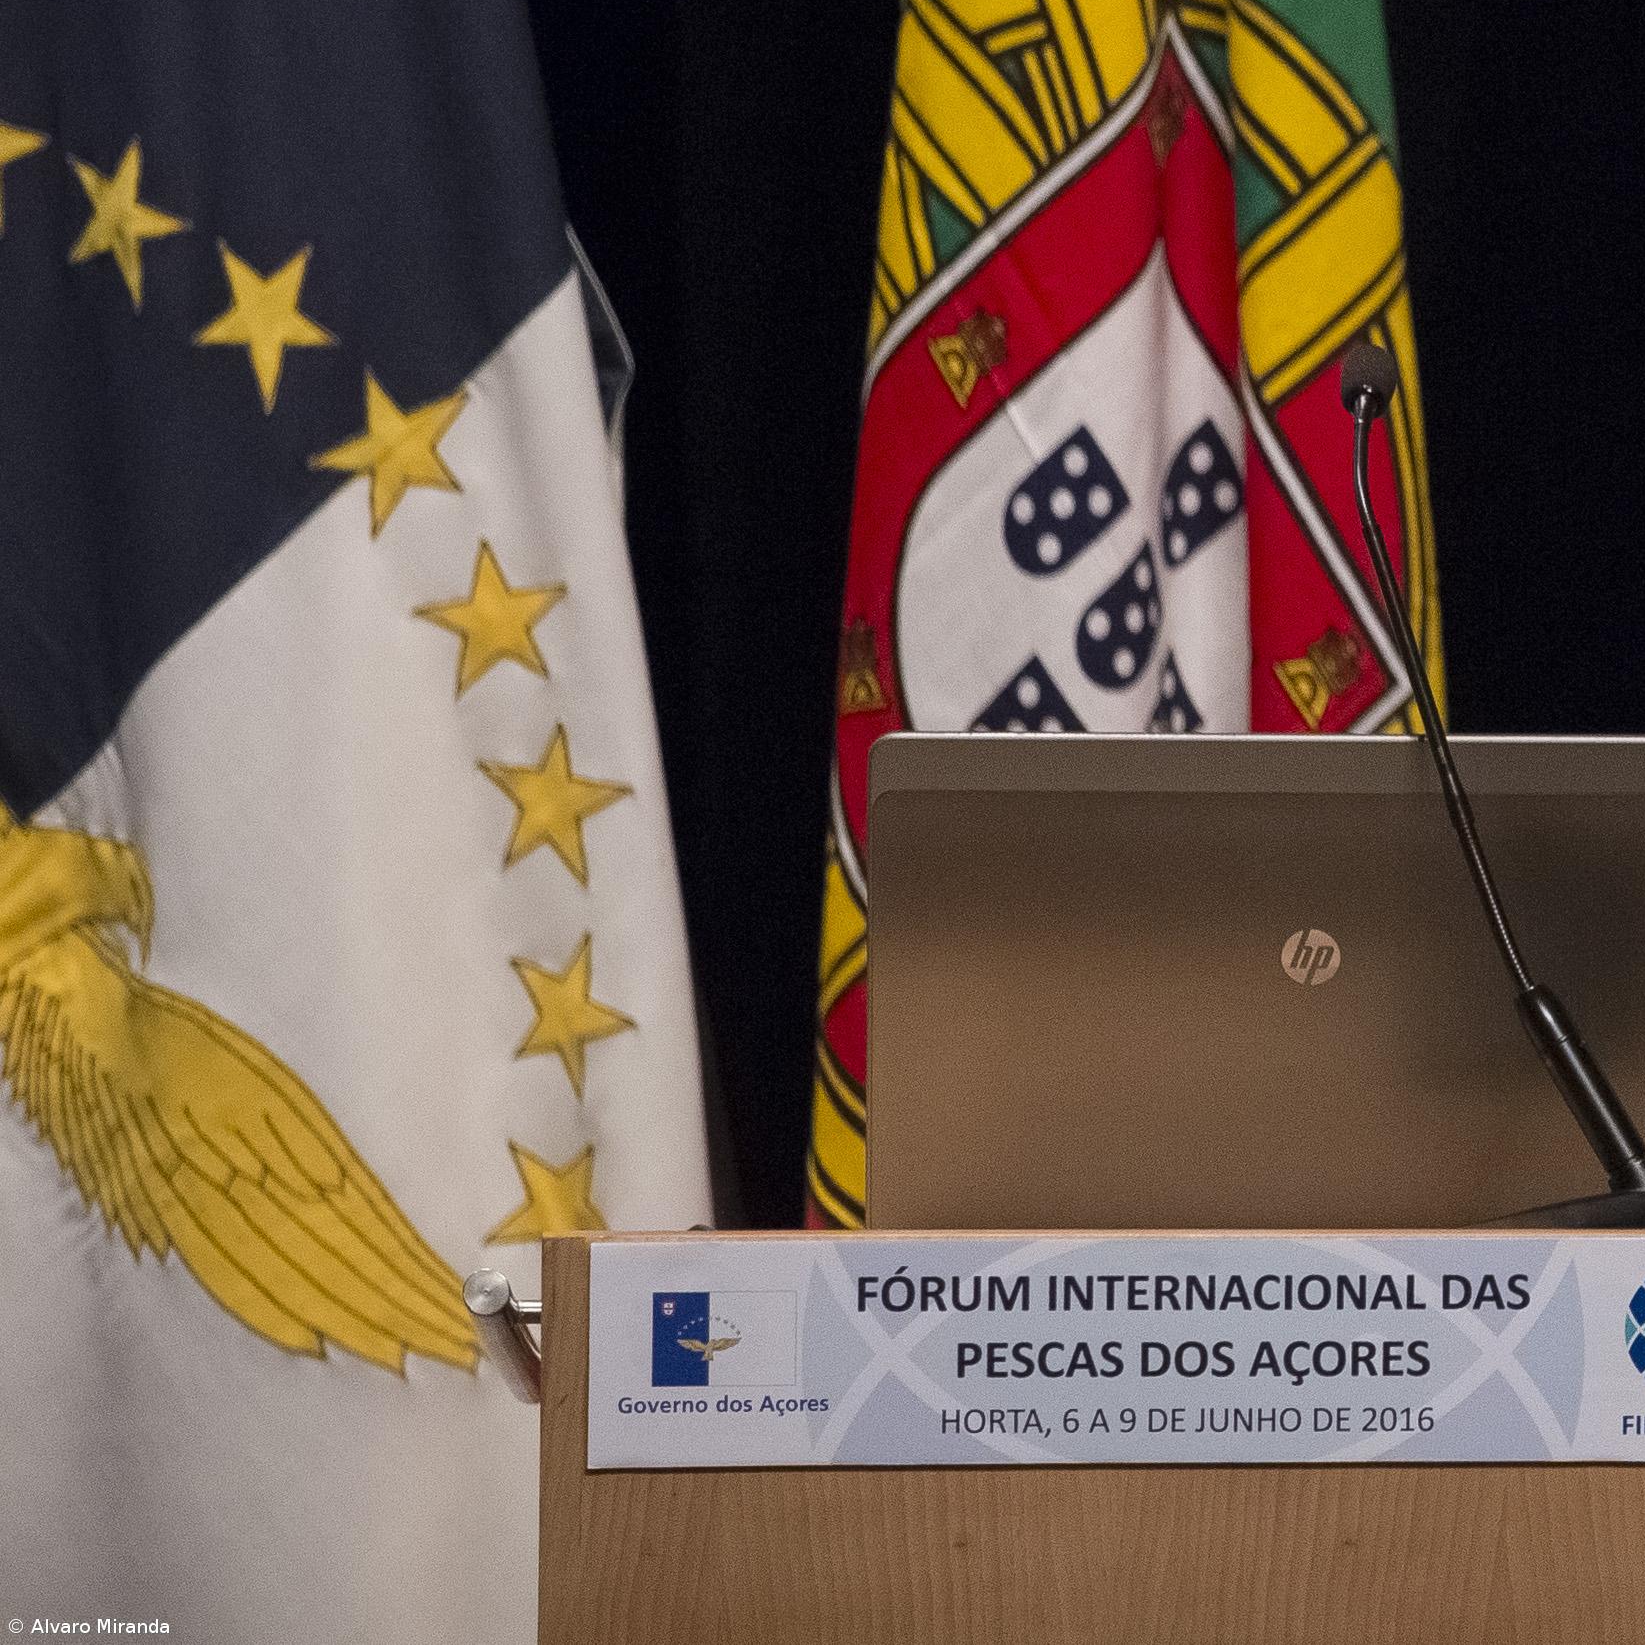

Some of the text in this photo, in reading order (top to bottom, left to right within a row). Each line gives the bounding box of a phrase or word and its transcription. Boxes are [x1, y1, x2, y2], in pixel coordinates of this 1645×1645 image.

[1288, 928, 1336, 986] hp
[857, 1265, 1530, 1313] FÓRUM INTERNACIONAL DAS
[957, 1340, 1431, 1387] PESCAS DOS AÇORES
[617, 1394, 829, 1417] Governo dos Açores
[941, 1406, 1435, 1439] HORTA, 6 A 9 DE JUNHO DE 2016
